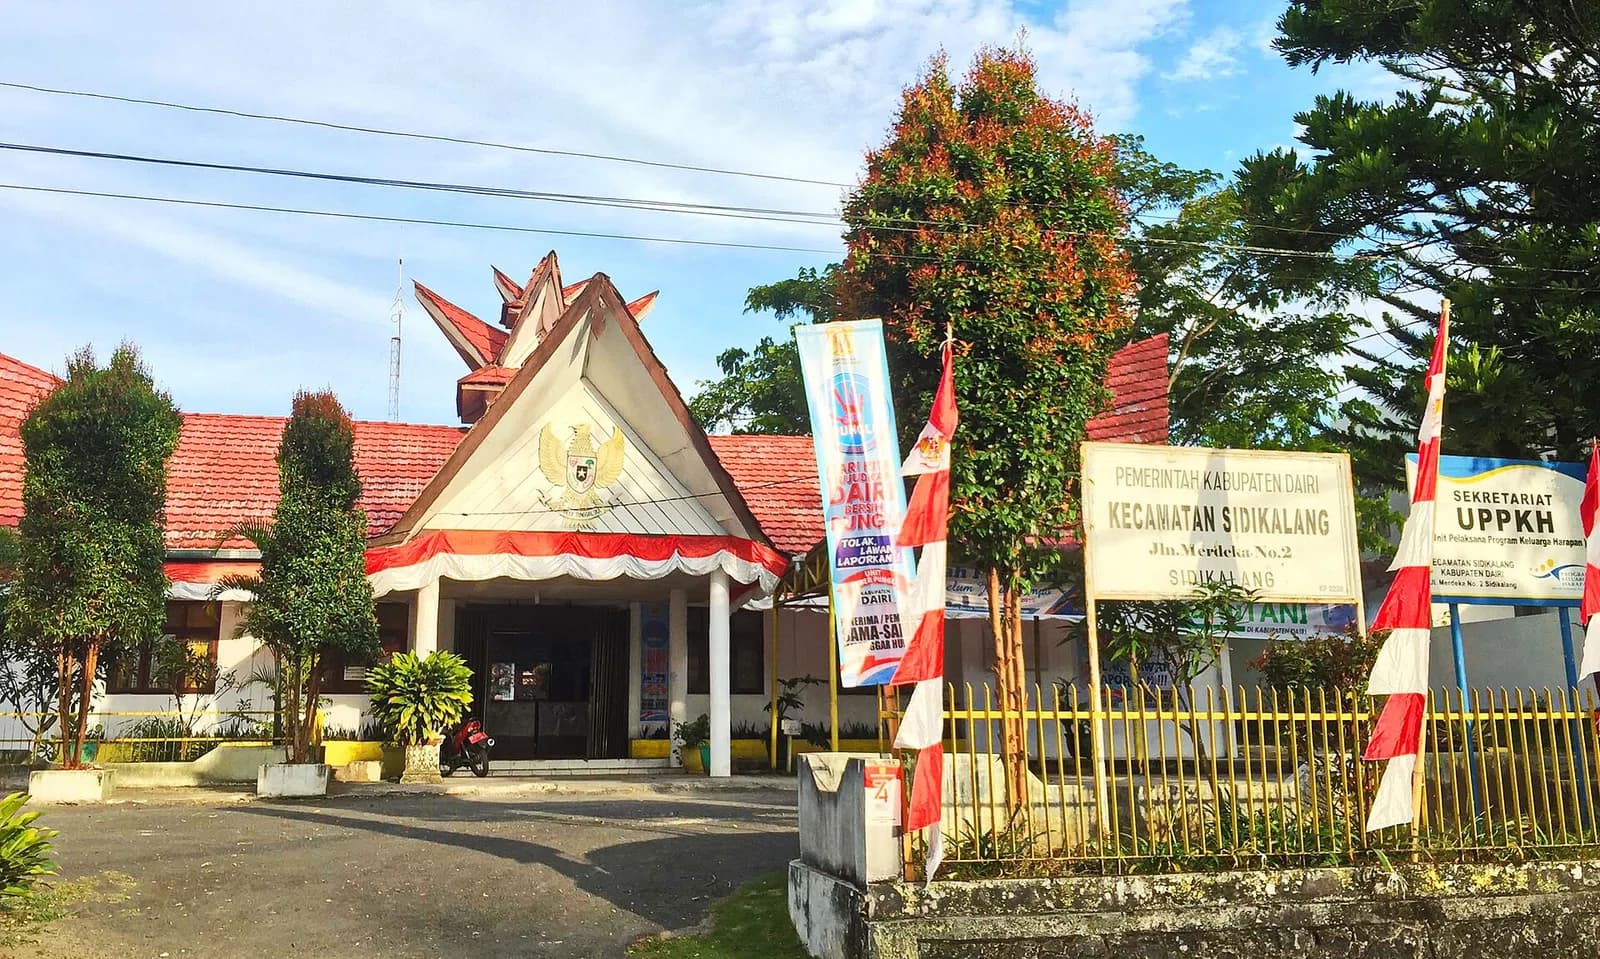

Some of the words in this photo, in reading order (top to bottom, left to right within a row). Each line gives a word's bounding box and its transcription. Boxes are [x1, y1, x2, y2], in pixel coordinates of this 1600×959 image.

[1116, 466, 1199, 490] PEMERINTAH
[1203, 471, 1282, 493] KABUPATEN
[1285, 474, 1320, 494] DAIRI
[1453, 490, 1552, 506] SEKRETARIAT
[1109, 501, 1216, 532] KECAMATAN
[1222, 506, 1330, 536] SIDIKALANG
[1457, 507, 1554, 534] UPPKH
[1449, 535, 1487, 544] Pelaksana
[1488, 536, 1518, 546] Program
[1519, 537, 1552, 548] Keluarga
[1432, 559, 1472, 568] ECAMATAN
[1473, 560, 1515, 569] SIDIKALANG
[1169, 569, 1275, 588] SIDIKALANG
[1441, 568, 1483, 577] KABUPATEN
[1485, 569, 1504, 578] DAIRI
[1439, 579, 1466, 587] Merdeka
[1485, 580, 1518, 589] Sidikalang
[861, 594, 892, 605] DAIRI
